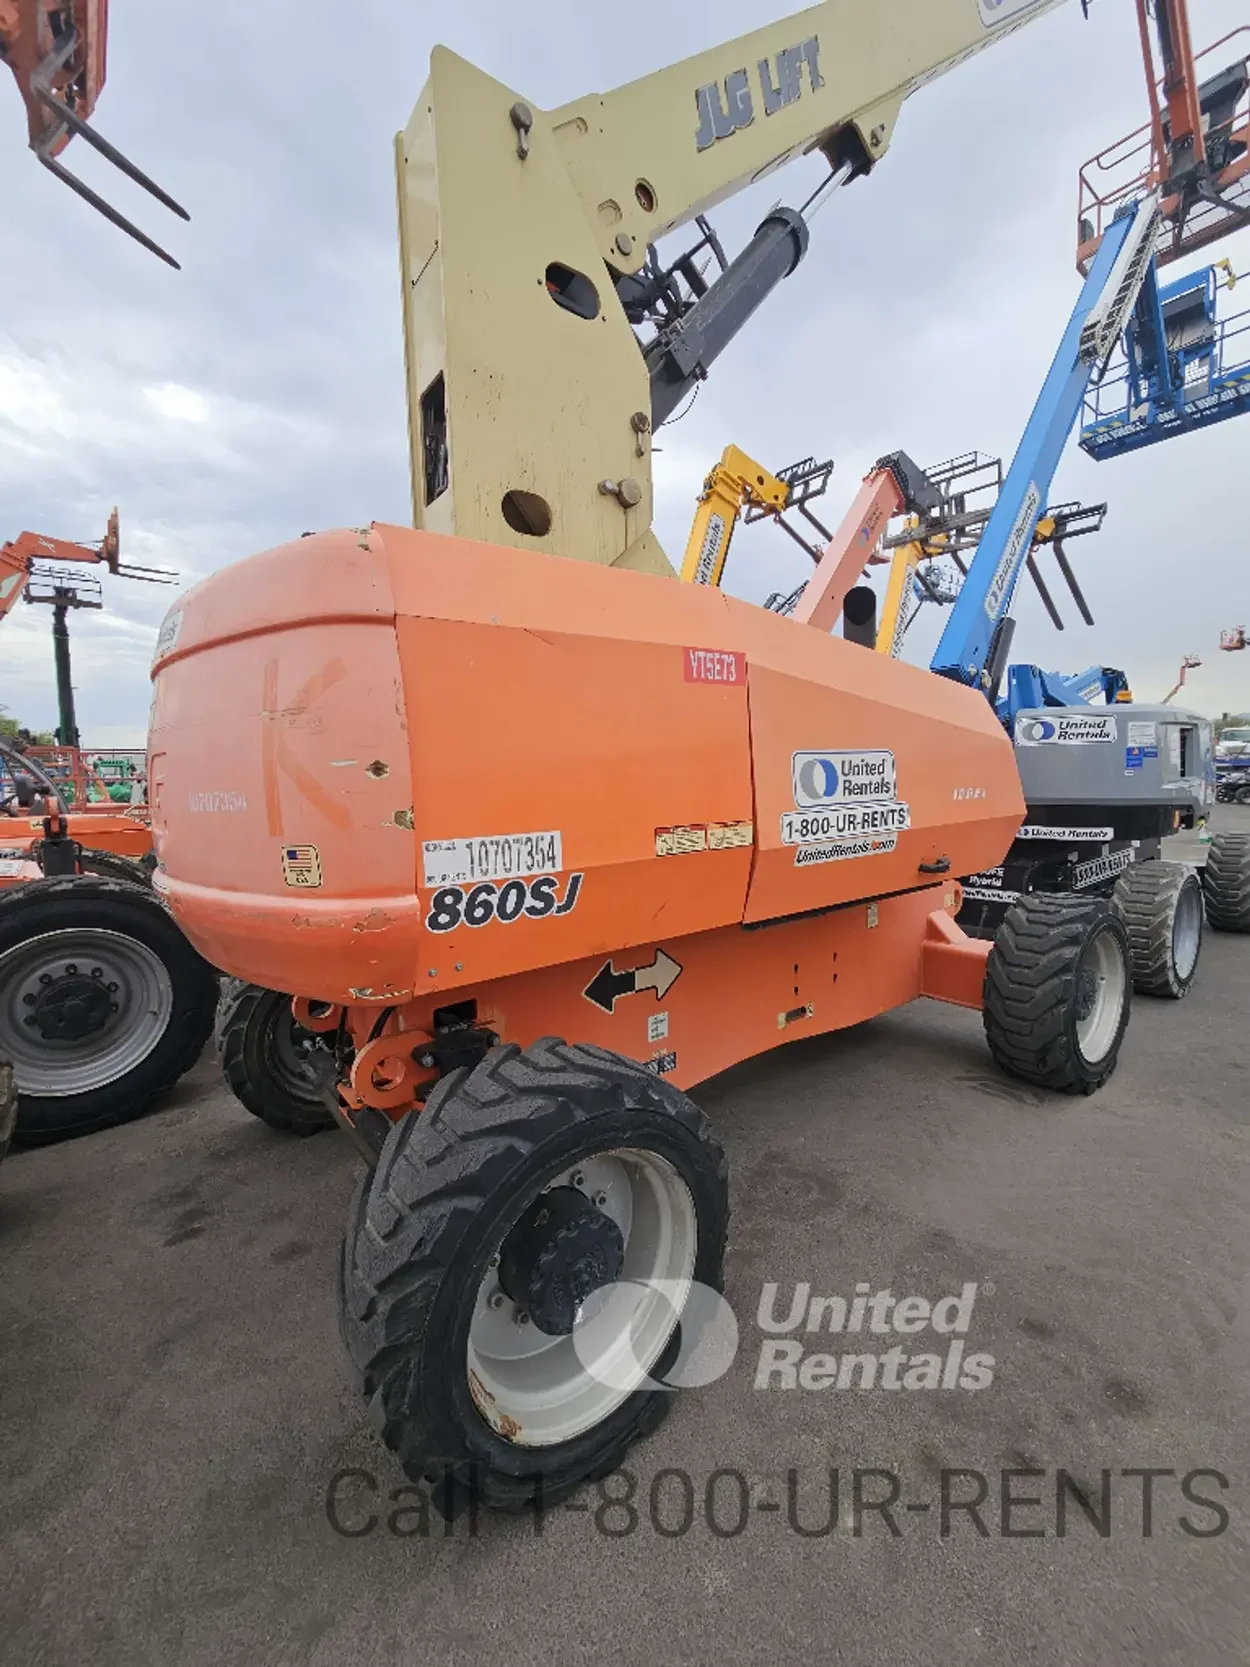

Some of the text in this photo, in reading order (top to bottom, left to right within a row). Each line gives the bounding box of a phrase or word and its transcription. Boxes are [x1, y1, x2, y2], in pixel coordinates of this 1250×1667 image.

[695, 34, 822, 153] JLG LIFT
[688, 649, 737, 682] YT5E73
[1057, 729, 1112, 741] Rentals
[1058, 718, 1108, 731] United
[841, 758, 886, 777] United
[842, 776, 892, 797] Rentals
[785, 807, 907, 840] 1-800-UR-RENTS
[1031, 827, 1109, 839] United Rentals
[465, 834, 556, 879] 10707354
[426, 873, 583, 933] 860SJ
